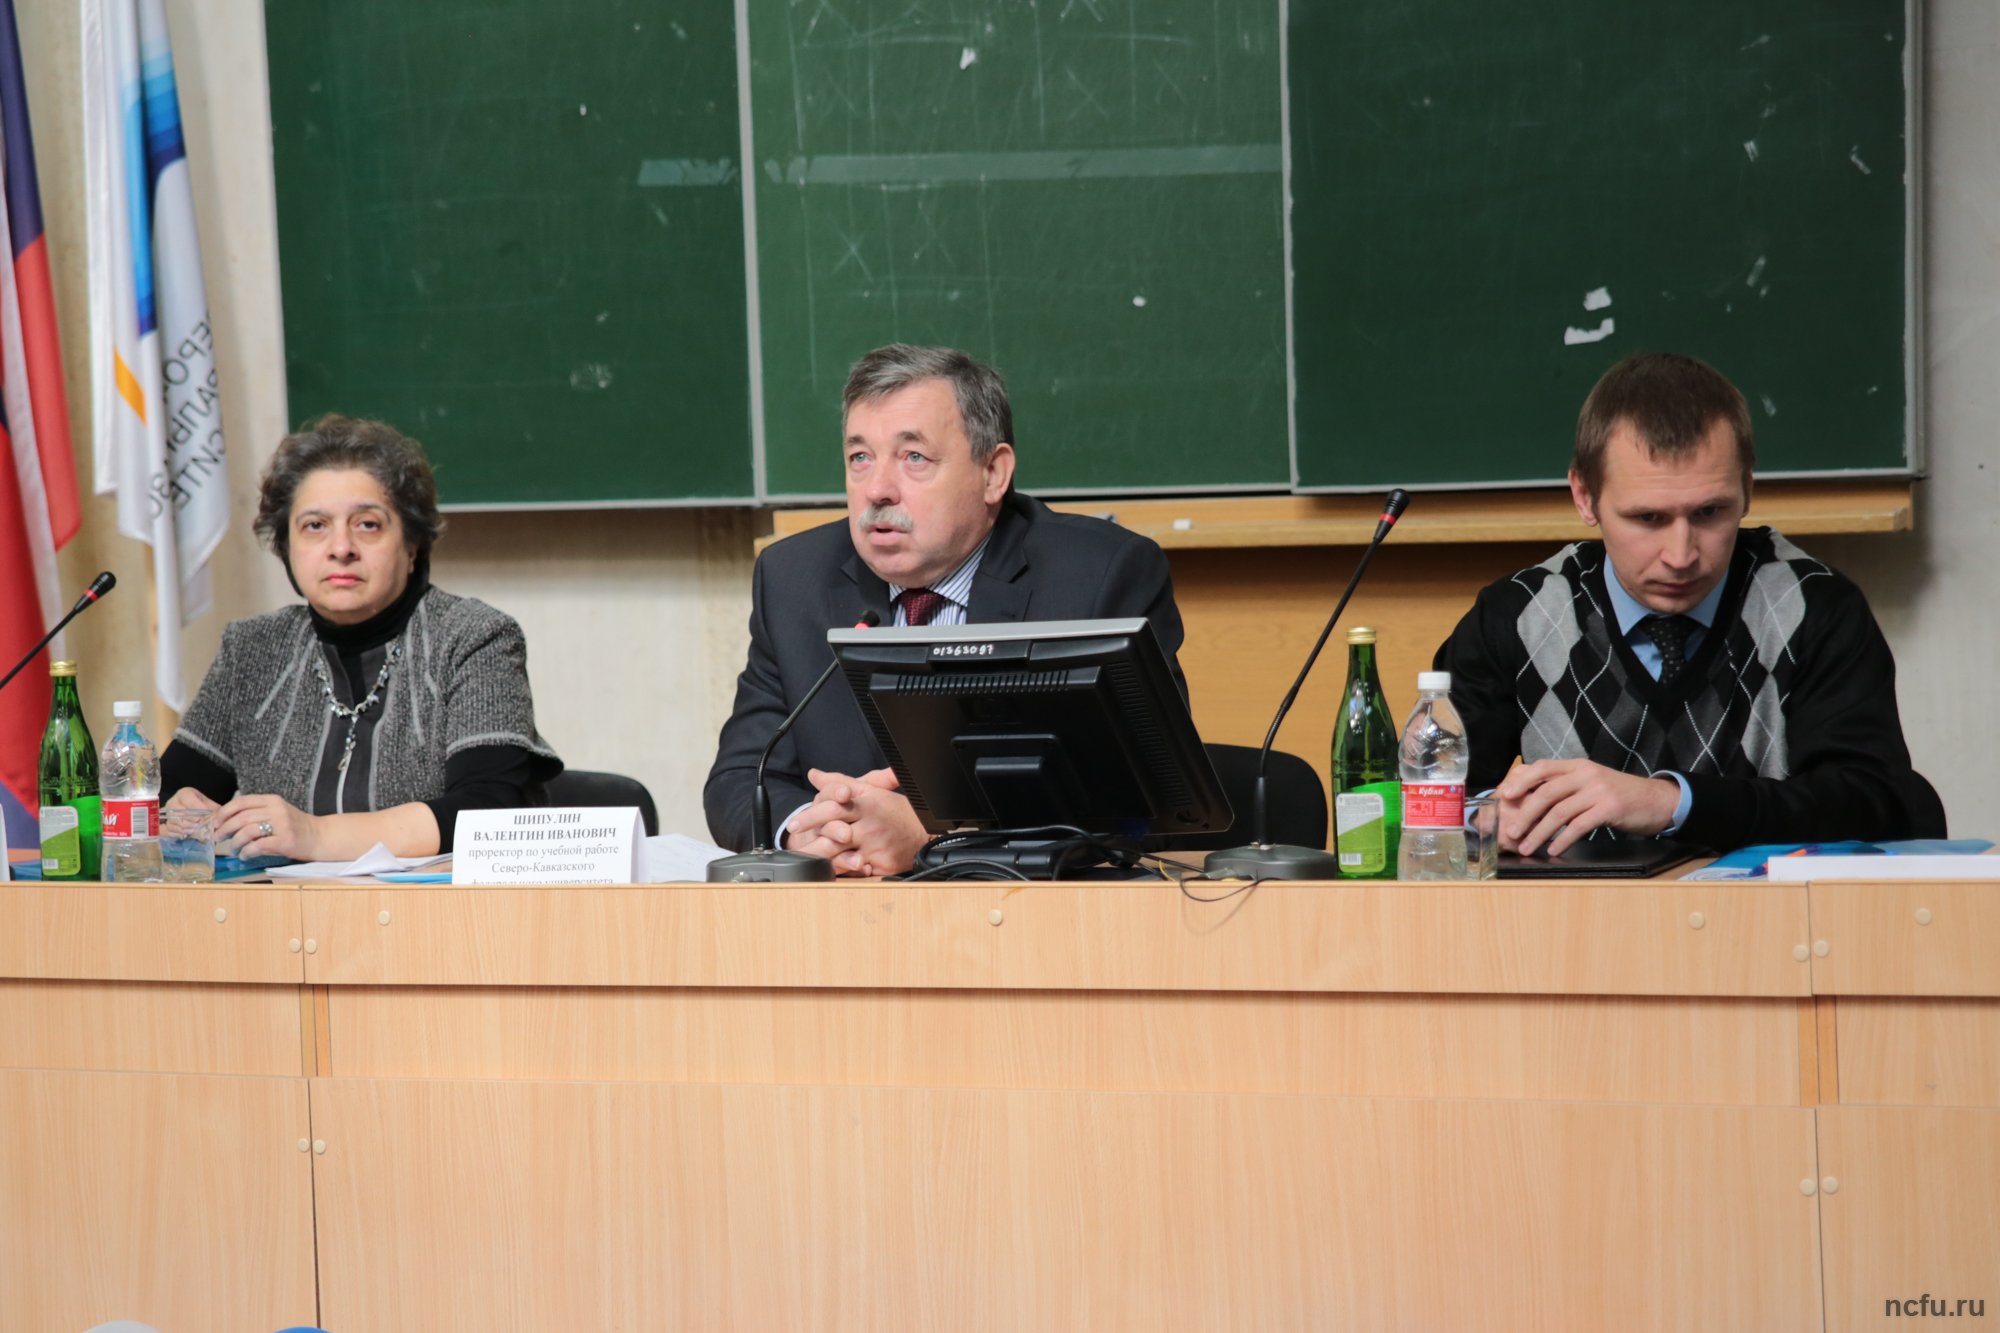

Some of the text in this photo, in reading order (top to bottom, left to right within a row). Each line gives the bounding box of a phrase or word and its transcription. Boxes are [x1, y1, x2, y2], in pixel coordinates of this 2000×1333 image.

[514, 813, 581, 825] ШИПУЛИН
[473, 827, 616, 841] ВАЛЕНТИН ИВАНОВИЧ
[468, 843, 619, 860] проректор по учебной работе
[491, 862, 595, 876] Северо-Кавказского
